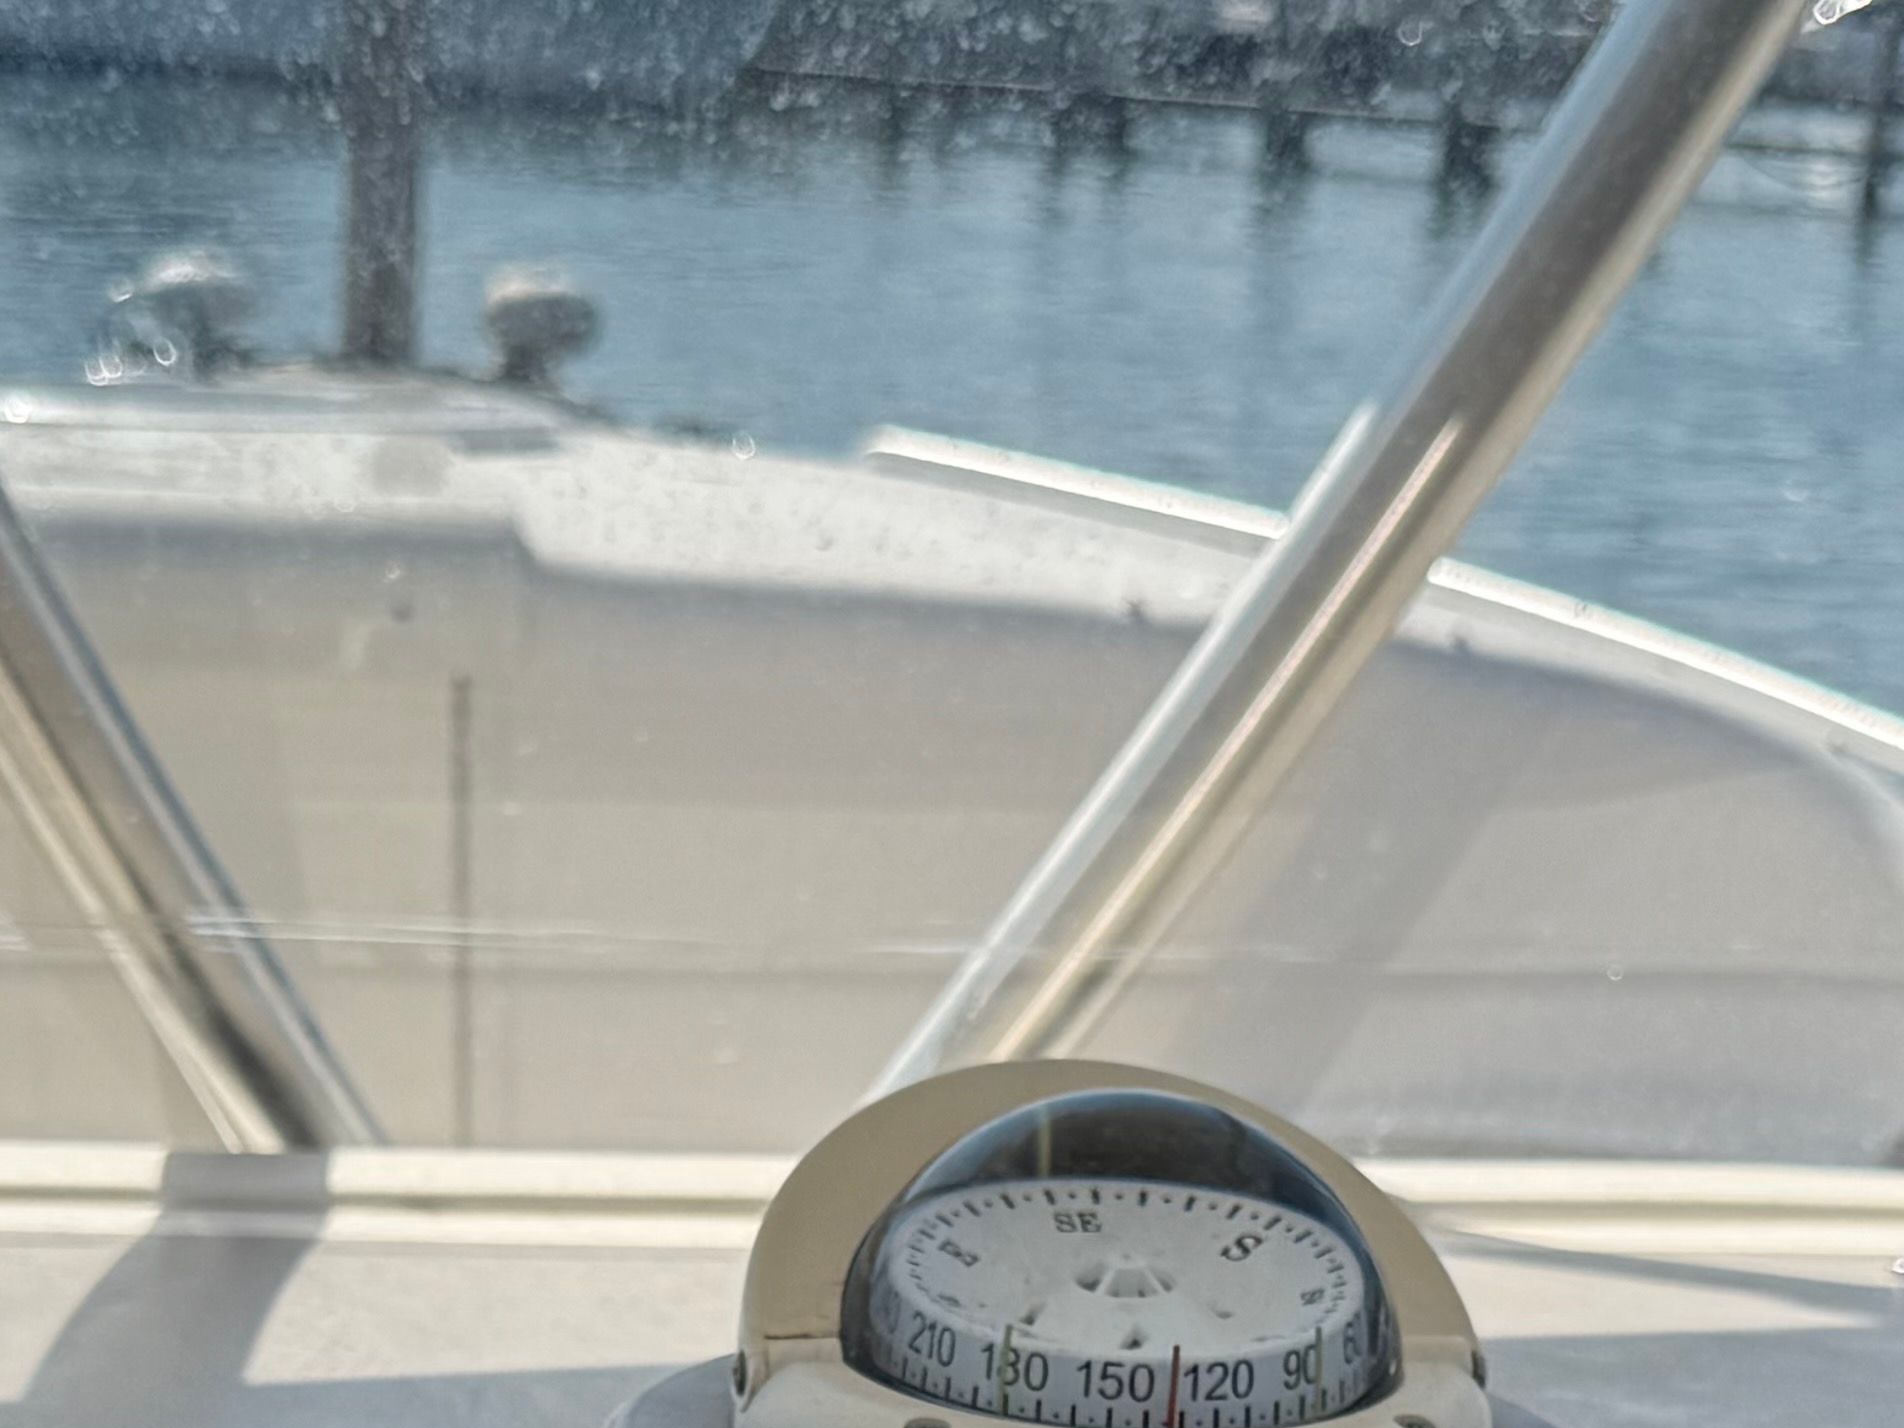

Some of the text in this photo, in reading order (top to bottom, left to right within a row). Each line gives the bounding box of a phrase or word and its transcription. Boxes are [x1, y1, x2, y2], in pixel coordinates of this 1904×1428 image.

[1053, 1211, 1102, 1233] SE
[1219, 1234, 1264, 1262] S
[908, 1310, 956, 1368] 210
[981, 1342, 1049, 1392] 180
[1076, 1359, 1155, 1402] 150
[1183, 1359, 1255, 1401] 120
[1283, 1343, 1322, 1391] 90
